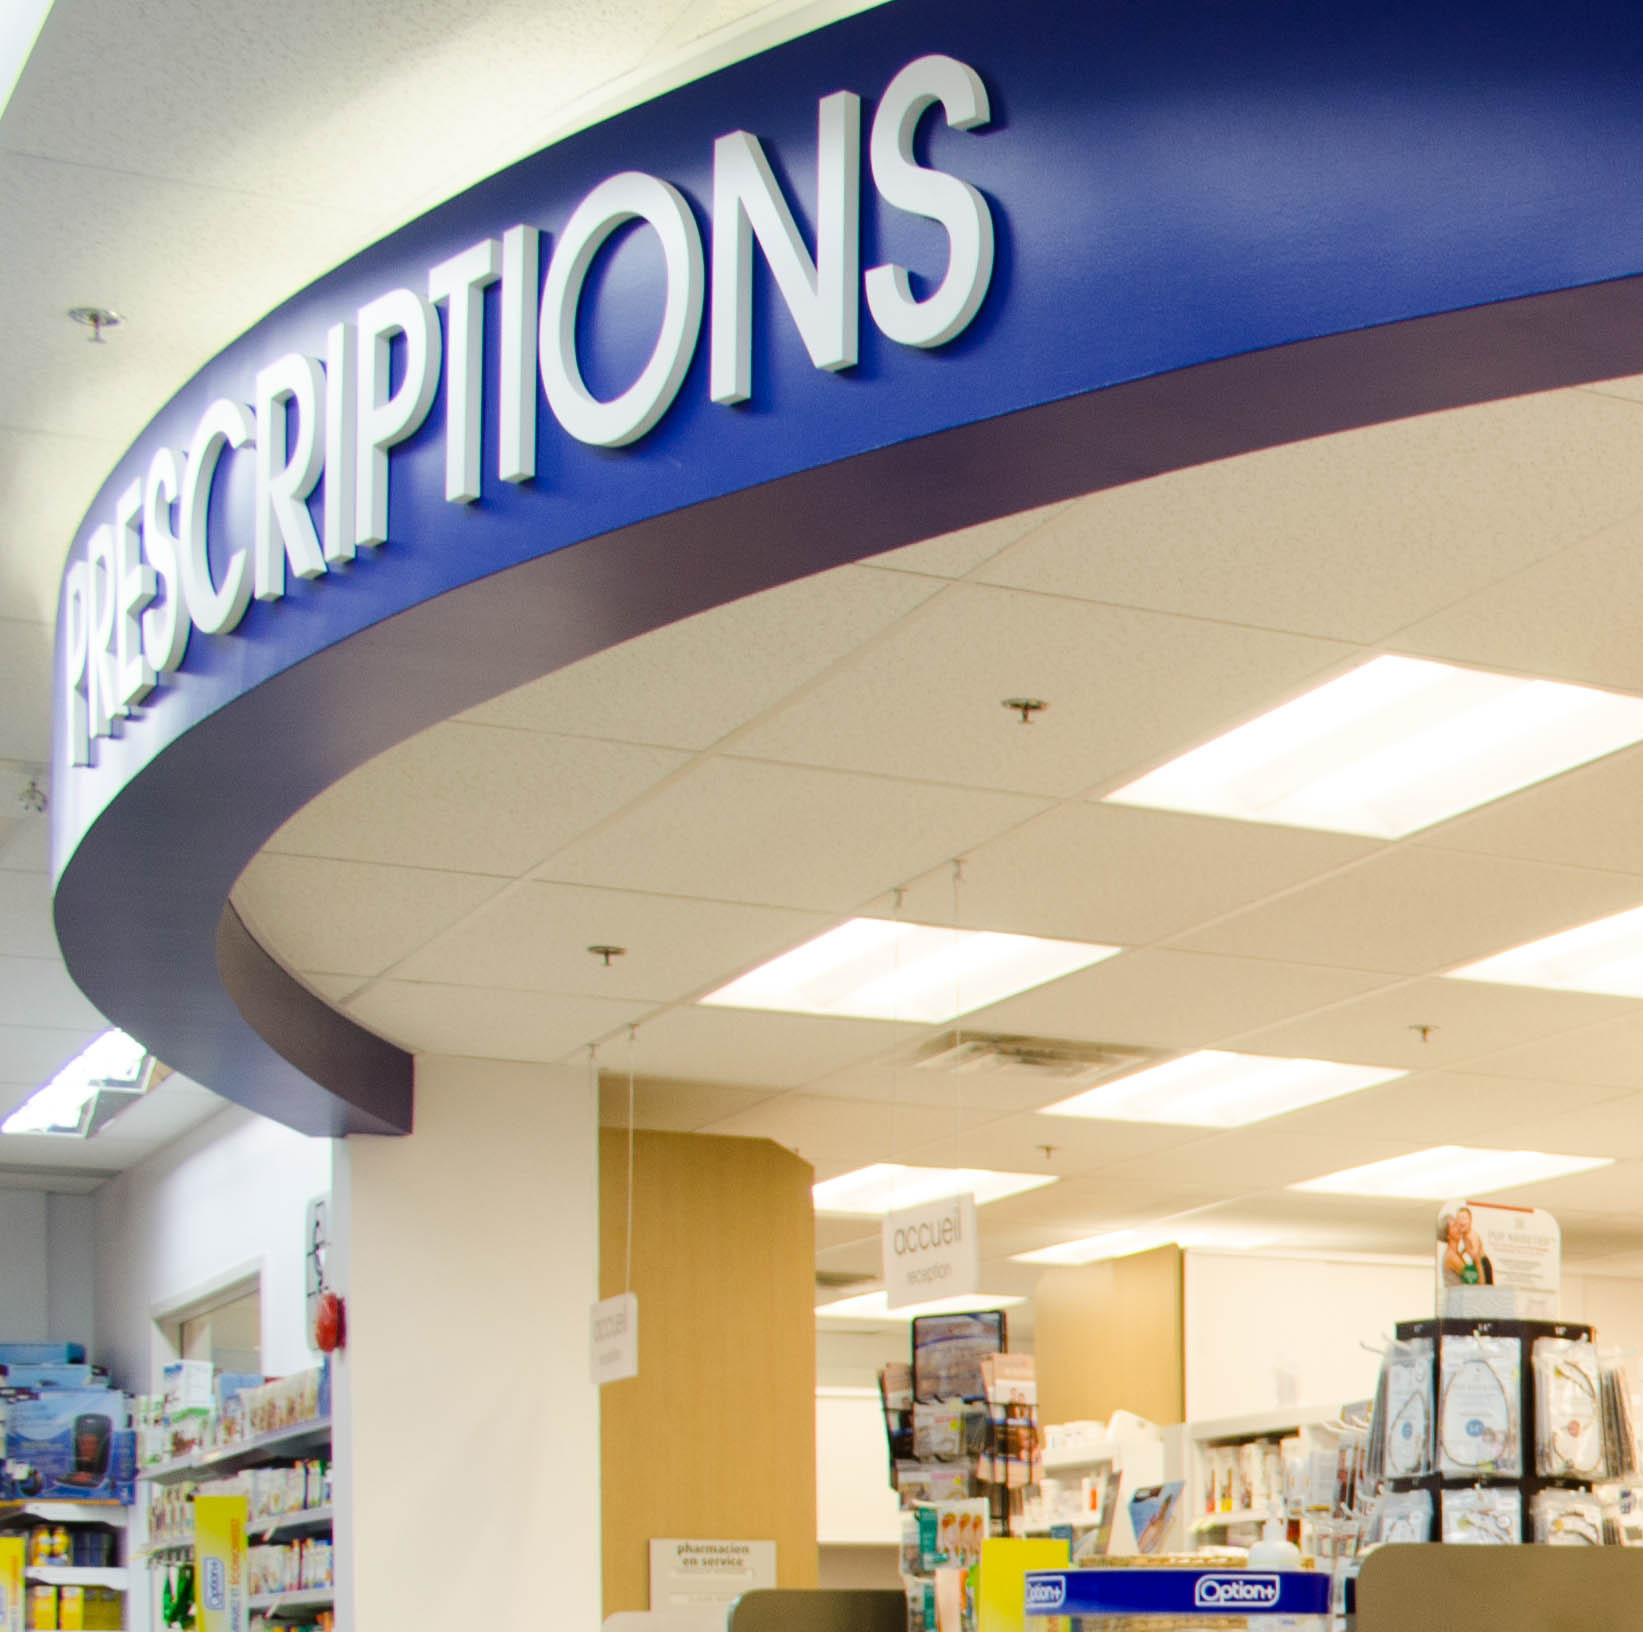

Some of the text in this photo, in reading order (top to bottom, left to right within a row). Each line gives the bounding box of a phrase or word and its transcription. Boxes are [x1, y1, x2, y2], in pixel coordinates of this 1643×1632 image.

[66, 54, 994, 766] PRESCRIPTIONS
[893, 1201, 962, 1256] accueil
[677, 1542, 750, 1556] pharmacien
[1200, 1580, 1277, 1606] Option+
